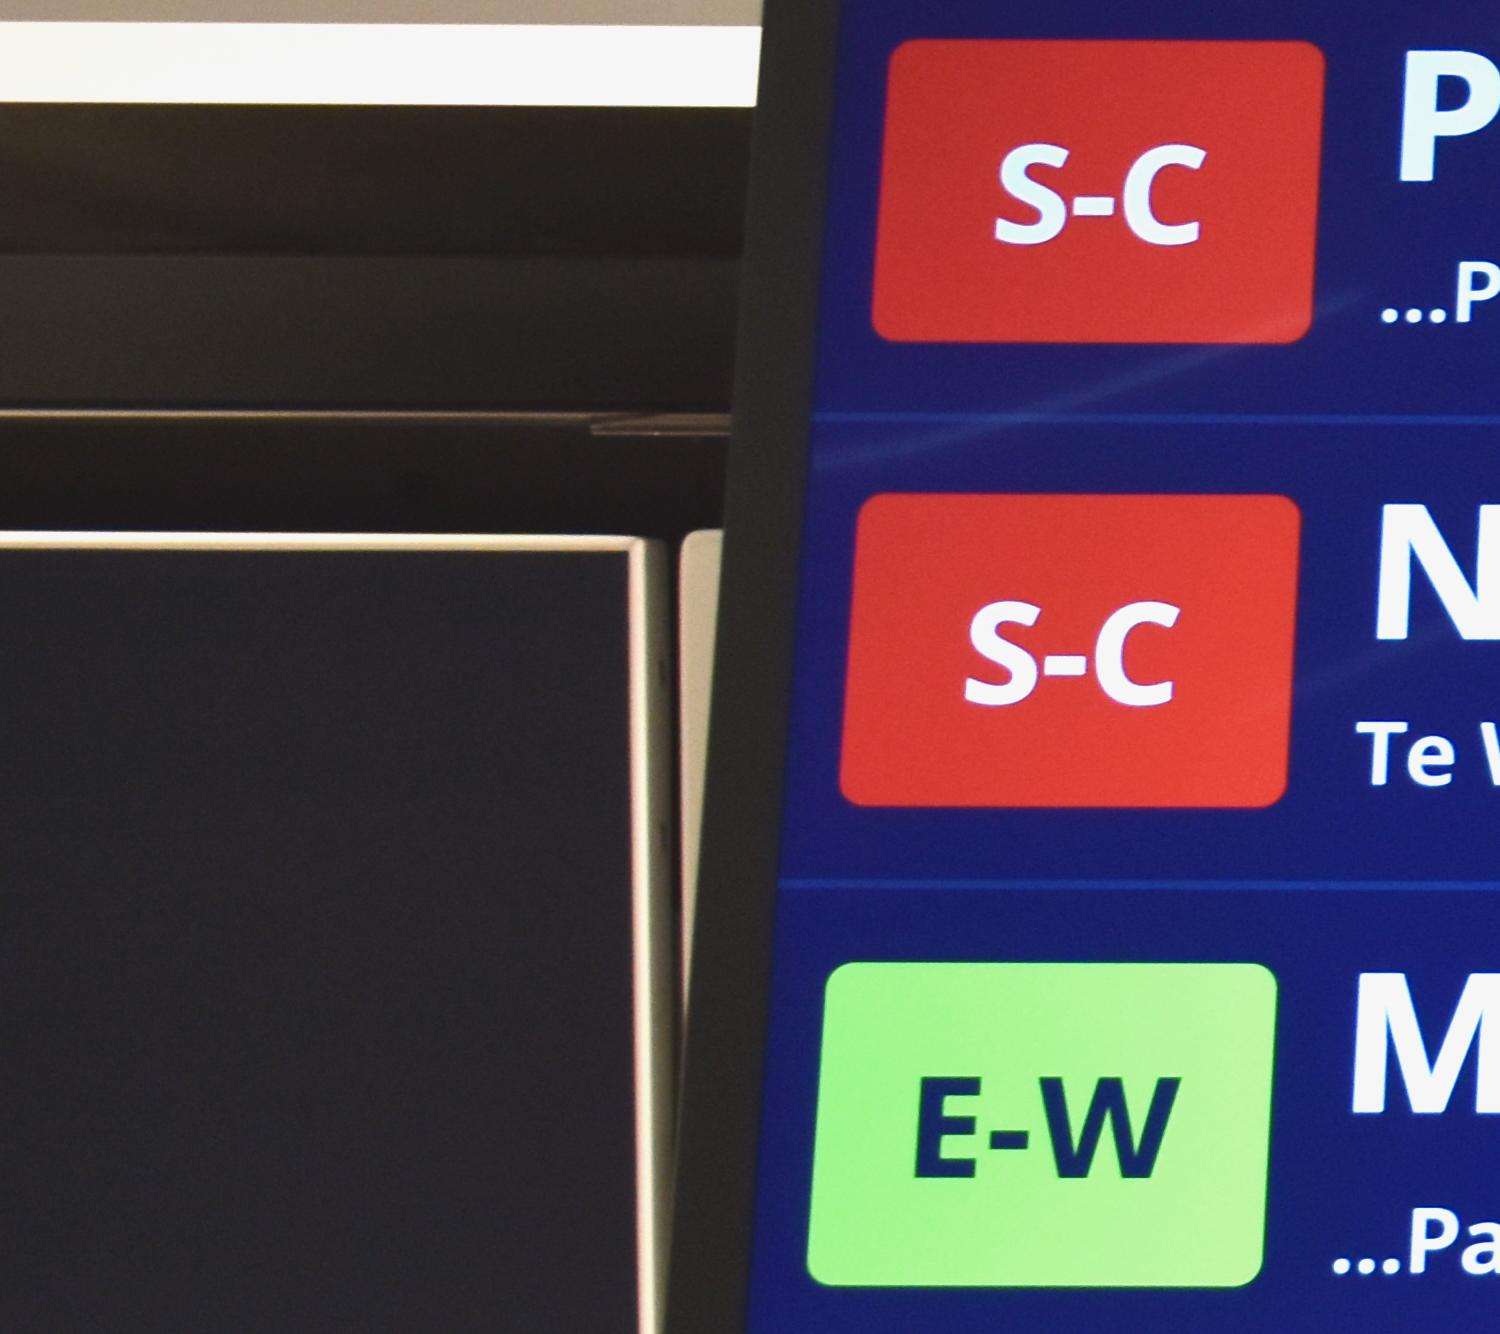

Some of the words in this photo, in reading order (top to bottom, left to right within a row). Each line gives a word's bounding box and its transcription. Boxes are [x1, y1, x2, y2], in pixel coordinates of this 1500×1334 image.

[994, 142, 1207, 247] S-C
[963, 599, 1181, 708] S-C
[1354, 720, 1456, 788] Te
[914, 1075, 1181, 1180] E-W
